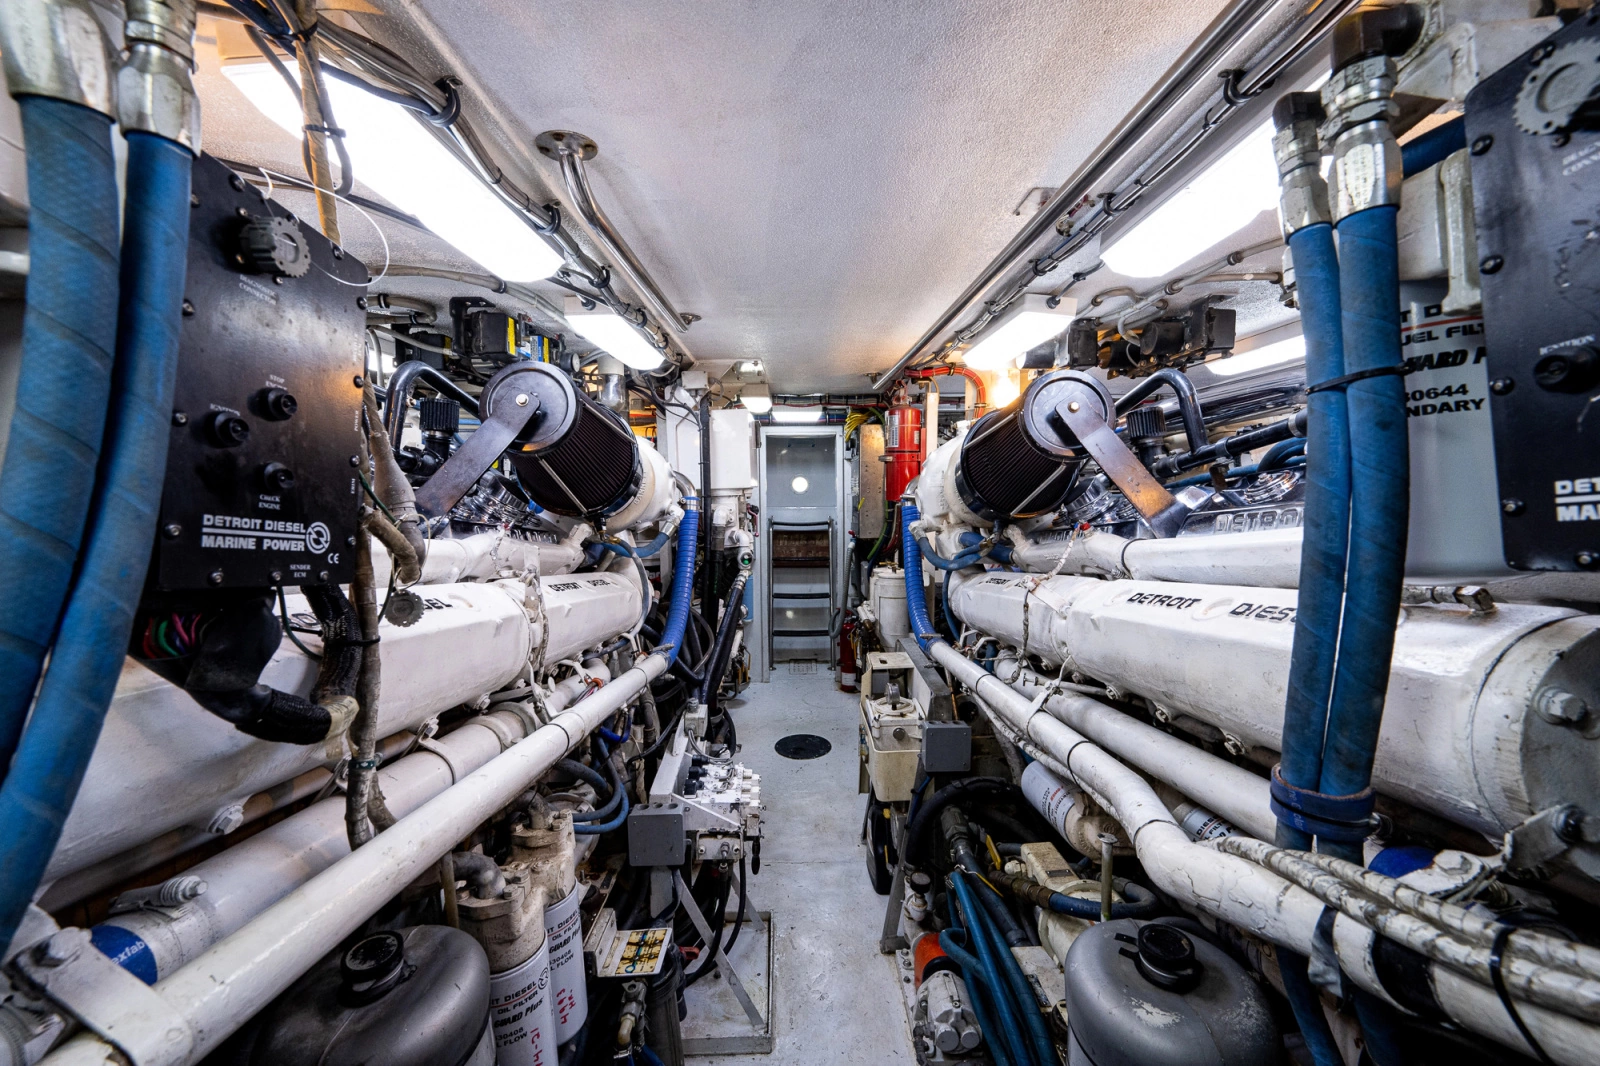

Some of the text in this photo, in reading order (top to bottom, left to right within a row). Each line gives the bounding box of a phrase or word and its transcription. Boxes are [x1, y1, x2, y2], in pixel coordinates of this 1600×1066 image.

[258, 501, 281, 510] ENGINE
[259, 494, 280, 502] CHECK
[1556, 503, 1600, 521] MA
[202, 514, 306, 533] DETROIT DIESEL
[201, 535, 305, 551] MARINE POWER
[1127, 592, 1296, 622] DETROIT DIES
[552, 933, 563, 941] OIL
[504, 981, 537, 1002] DIESEL
[497, 990, 538, 1015] OIL FILTER
[525, 997, 543, 1016] Plus
[504, 1031, 527, 1047] FLOW
